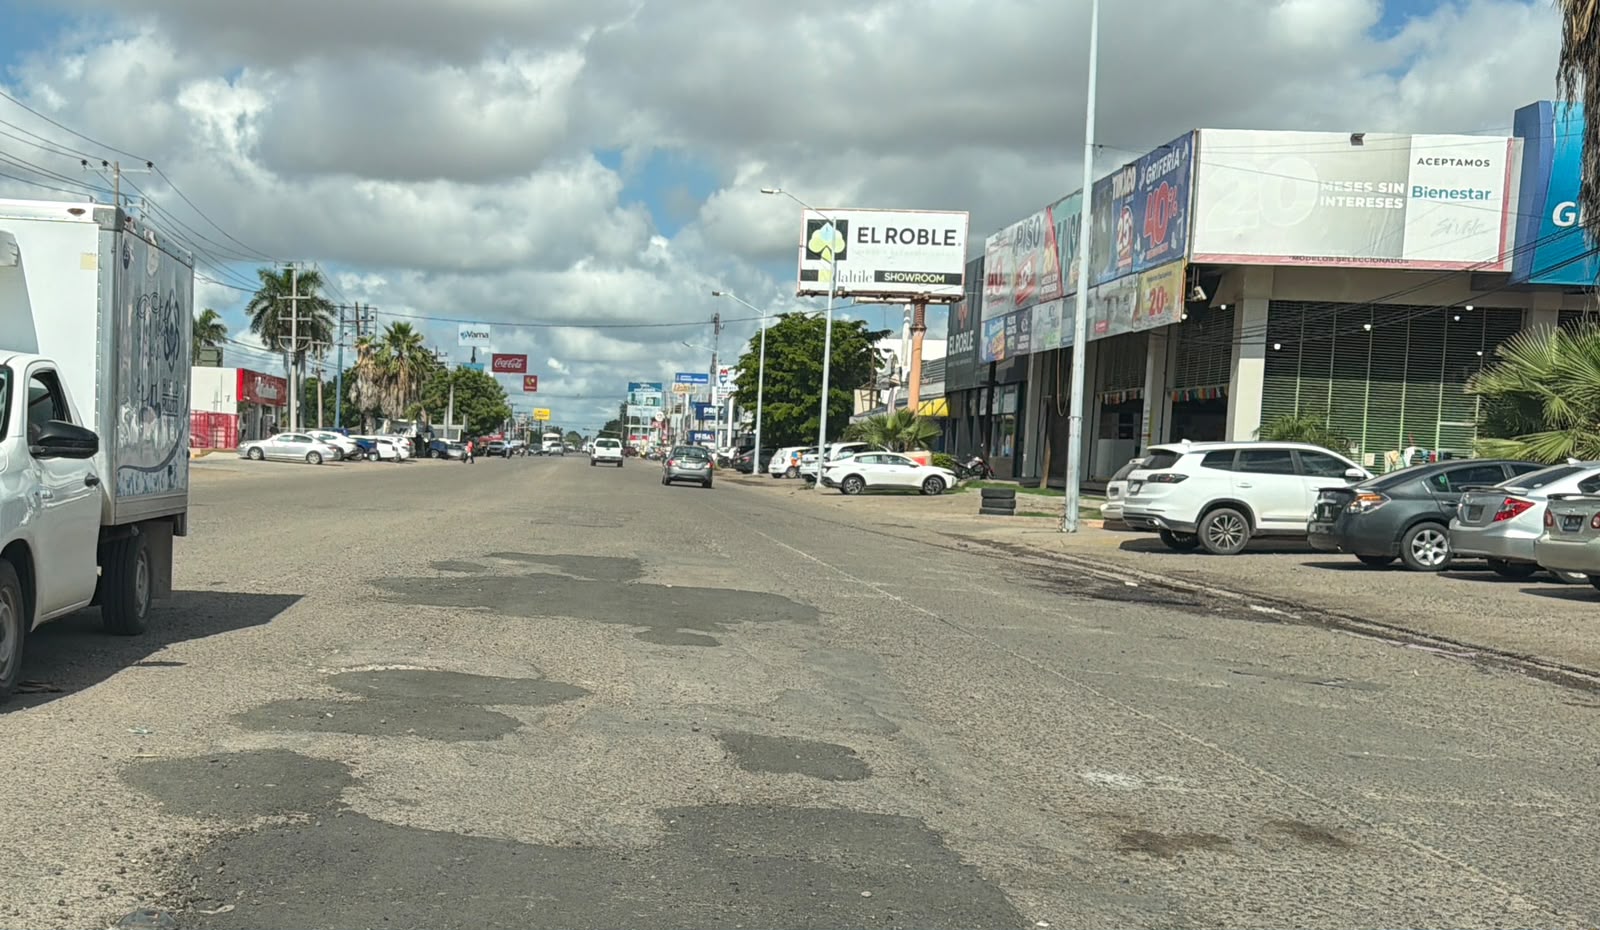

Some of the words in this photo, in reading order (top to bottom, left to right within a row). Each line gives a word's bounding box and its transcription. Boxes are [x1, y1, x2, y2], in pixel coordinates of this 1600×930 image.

[1416, 157, 1491, 168] ACEPTAMOS
[1320, 181, 1373, 193] MESES
[1377, 182, 1405, 194] SIN
[1411, 185, 1492, 201] Bienestar
[1319, 196, 1404, 209] INTERESES
[857, 227, 881, 244] EL
[885, 227, 957, 247] ROBLE
[884, 272, 945, 284] SHOWROOM
